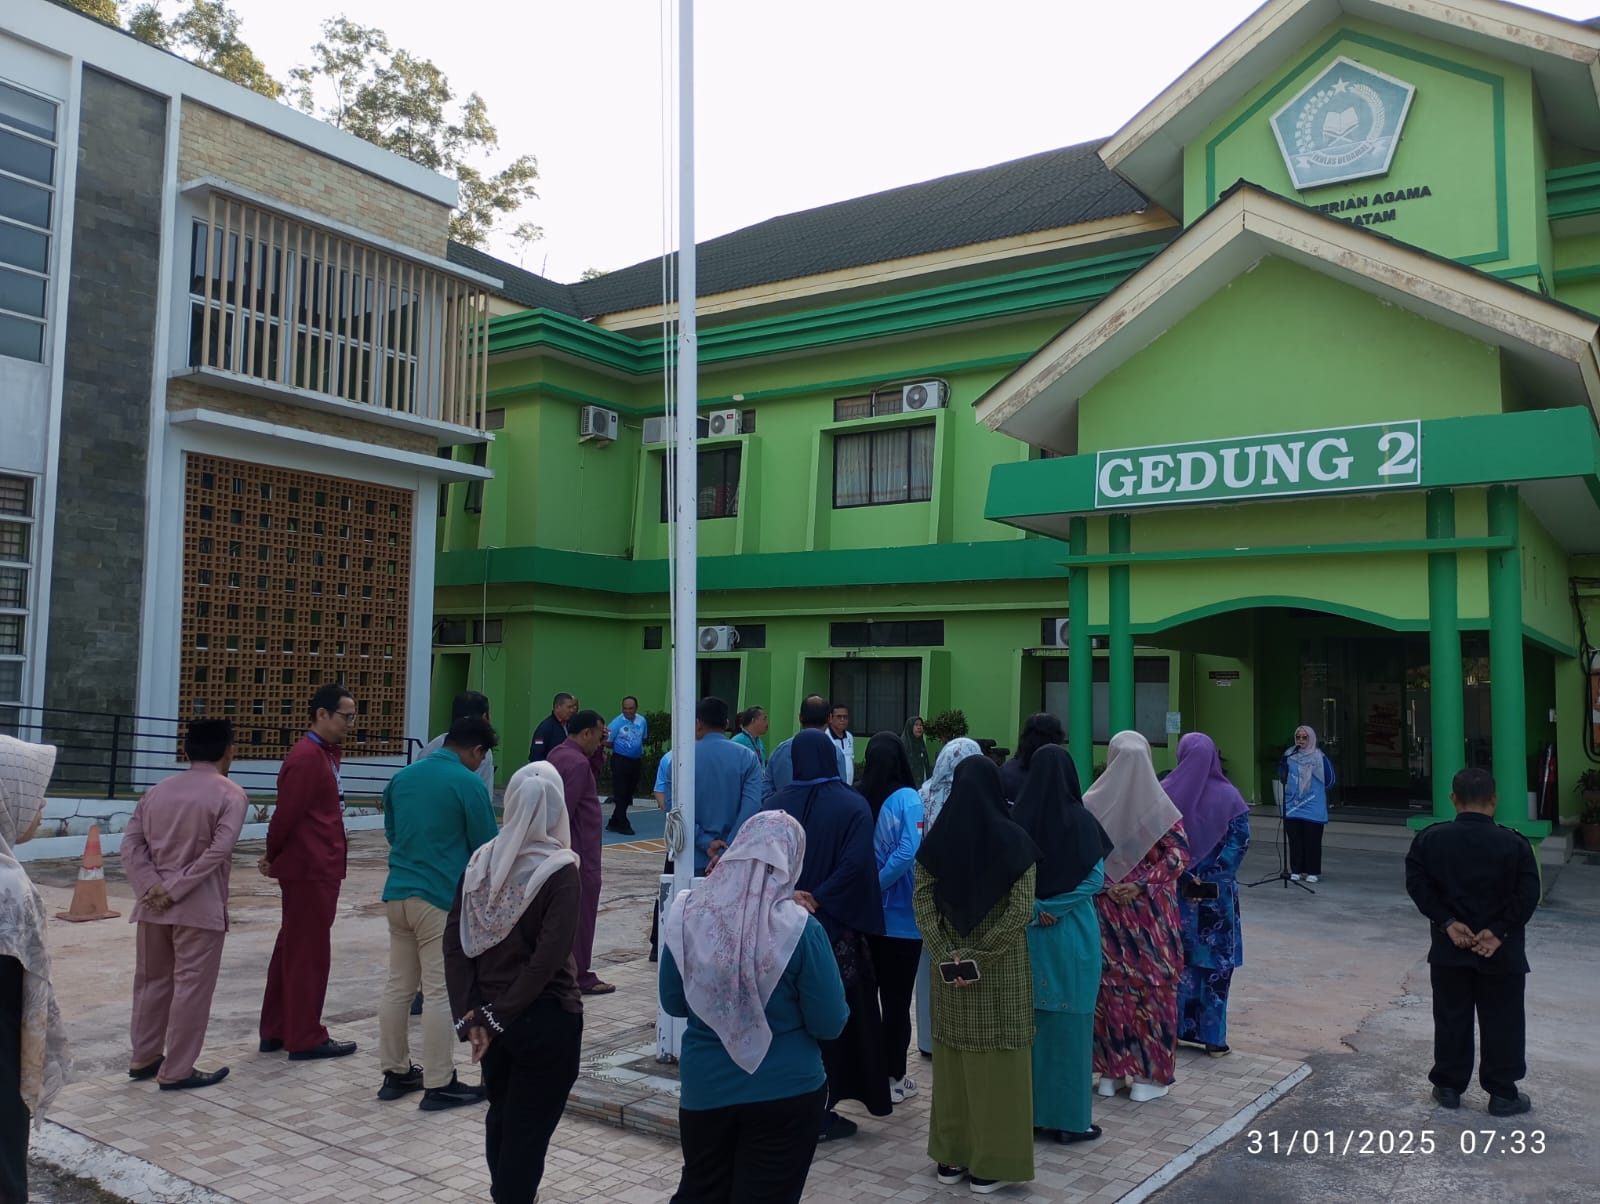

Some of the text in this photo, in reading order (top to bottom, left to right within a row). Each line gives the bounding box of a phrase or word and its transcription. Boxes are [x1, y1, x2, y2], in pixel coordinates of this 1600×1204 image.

[1372, 186, 1432, 206] AGAMA
[1099, 431, 1417, 498] GEDUNG 2
